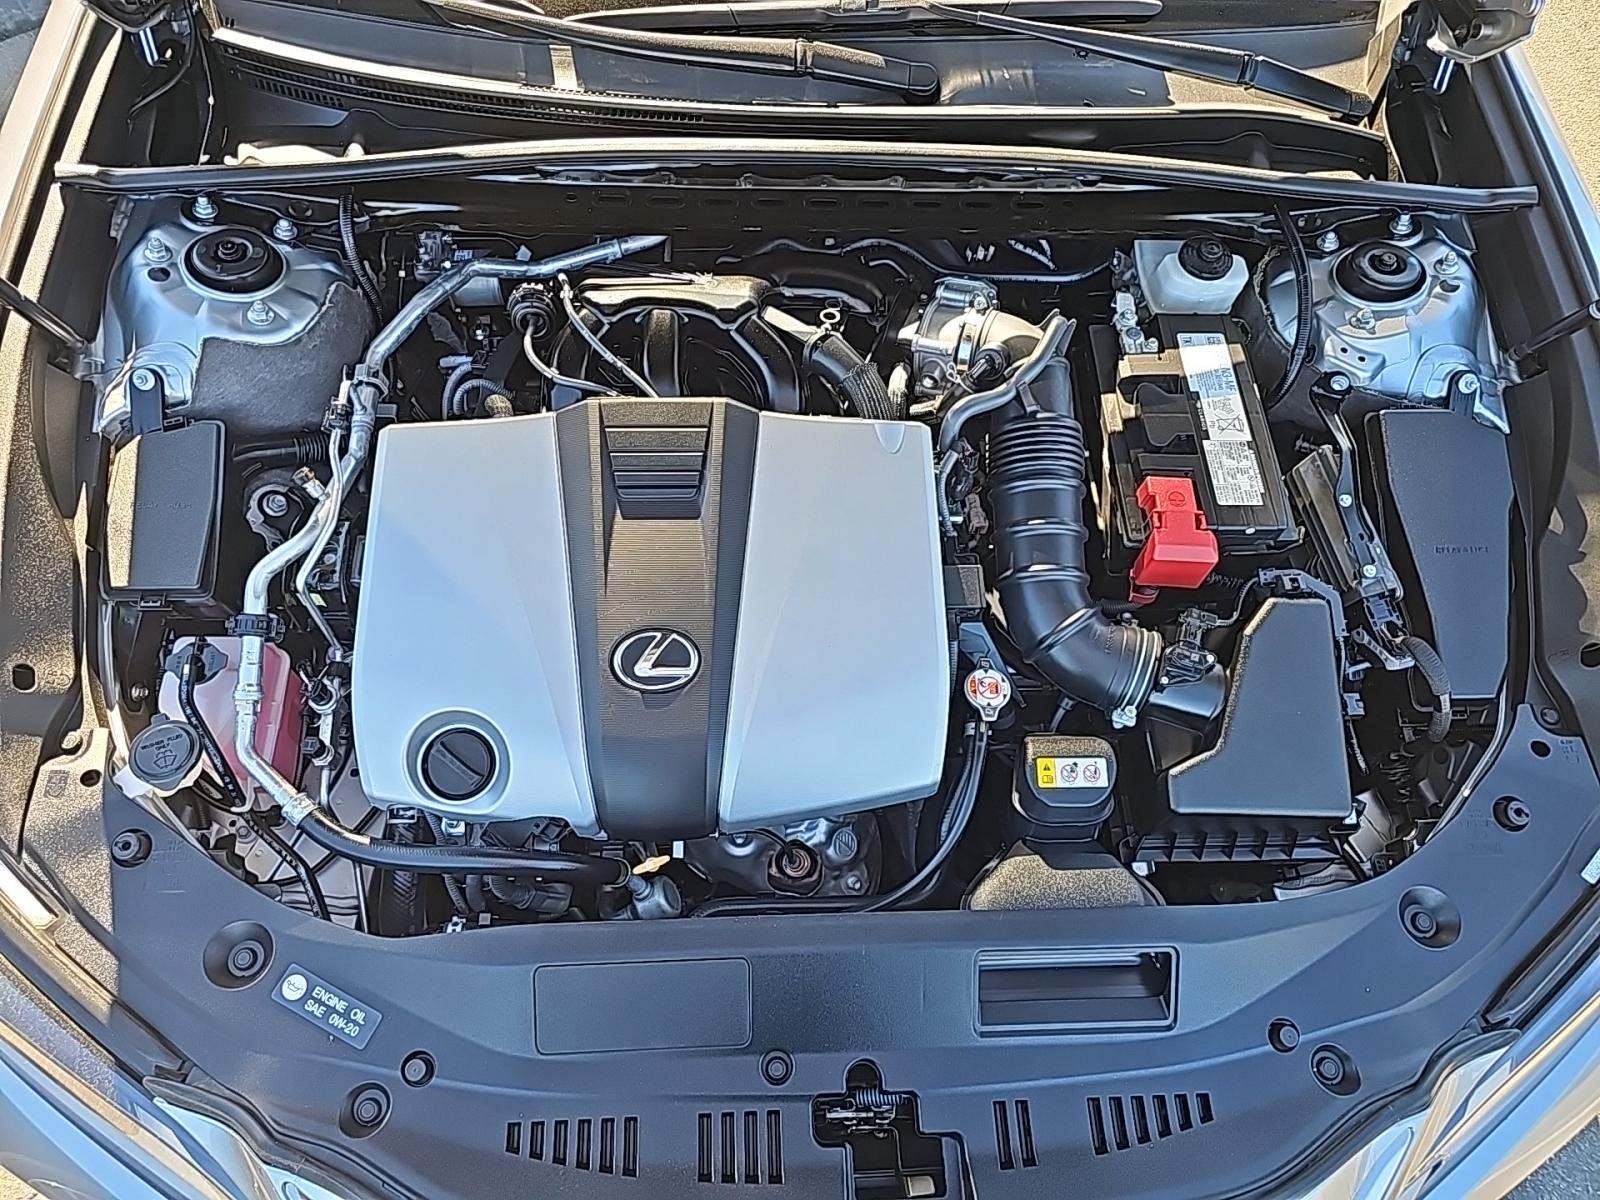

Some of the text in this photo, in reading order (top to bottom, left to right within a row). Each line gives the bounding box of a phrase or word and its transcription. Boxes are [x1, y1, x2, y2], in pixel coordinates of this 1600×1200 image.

[304, 999, 360, 1037] SAE 0W-20
[311, 986, 367, 1025] ENGINE OIL
